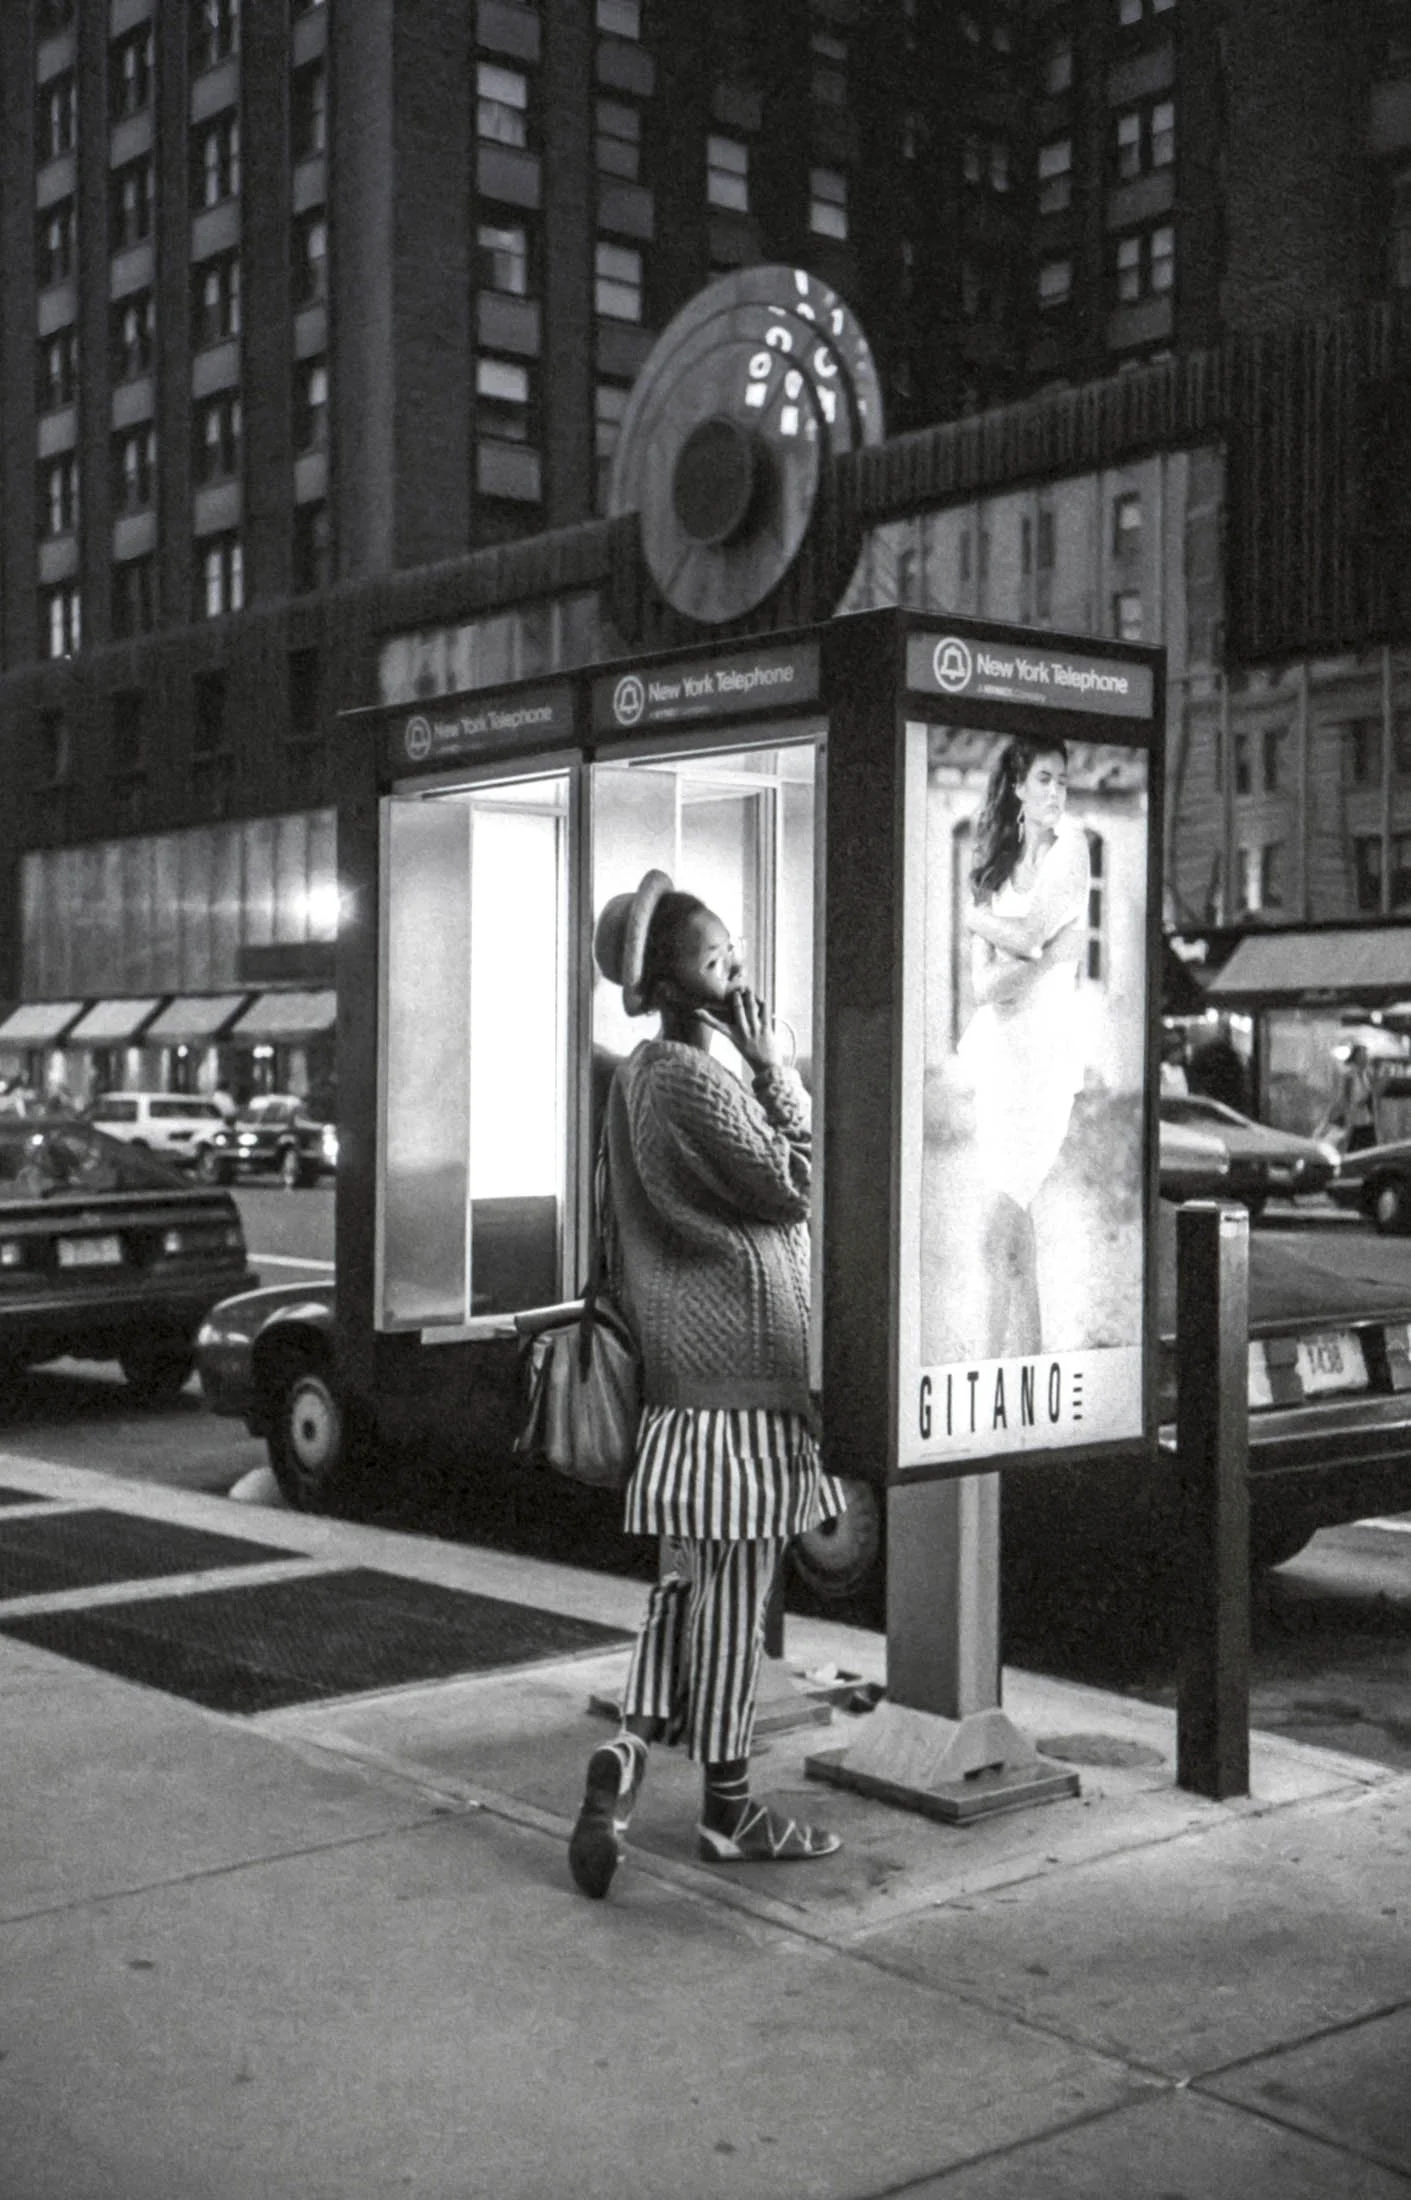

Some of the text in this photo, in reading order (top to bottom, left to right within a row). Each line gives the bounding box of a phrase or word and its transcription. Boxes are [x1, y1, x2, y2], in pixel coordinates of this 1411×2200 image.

[648, 665, 794, 702] New York Telephone
[976, 653, 1014, 679] New
[1016, 658, 1049, 684] York
[1050, 663, 1129, 694] Telephone
[919, 1362, 1061, 1440] GITANO
